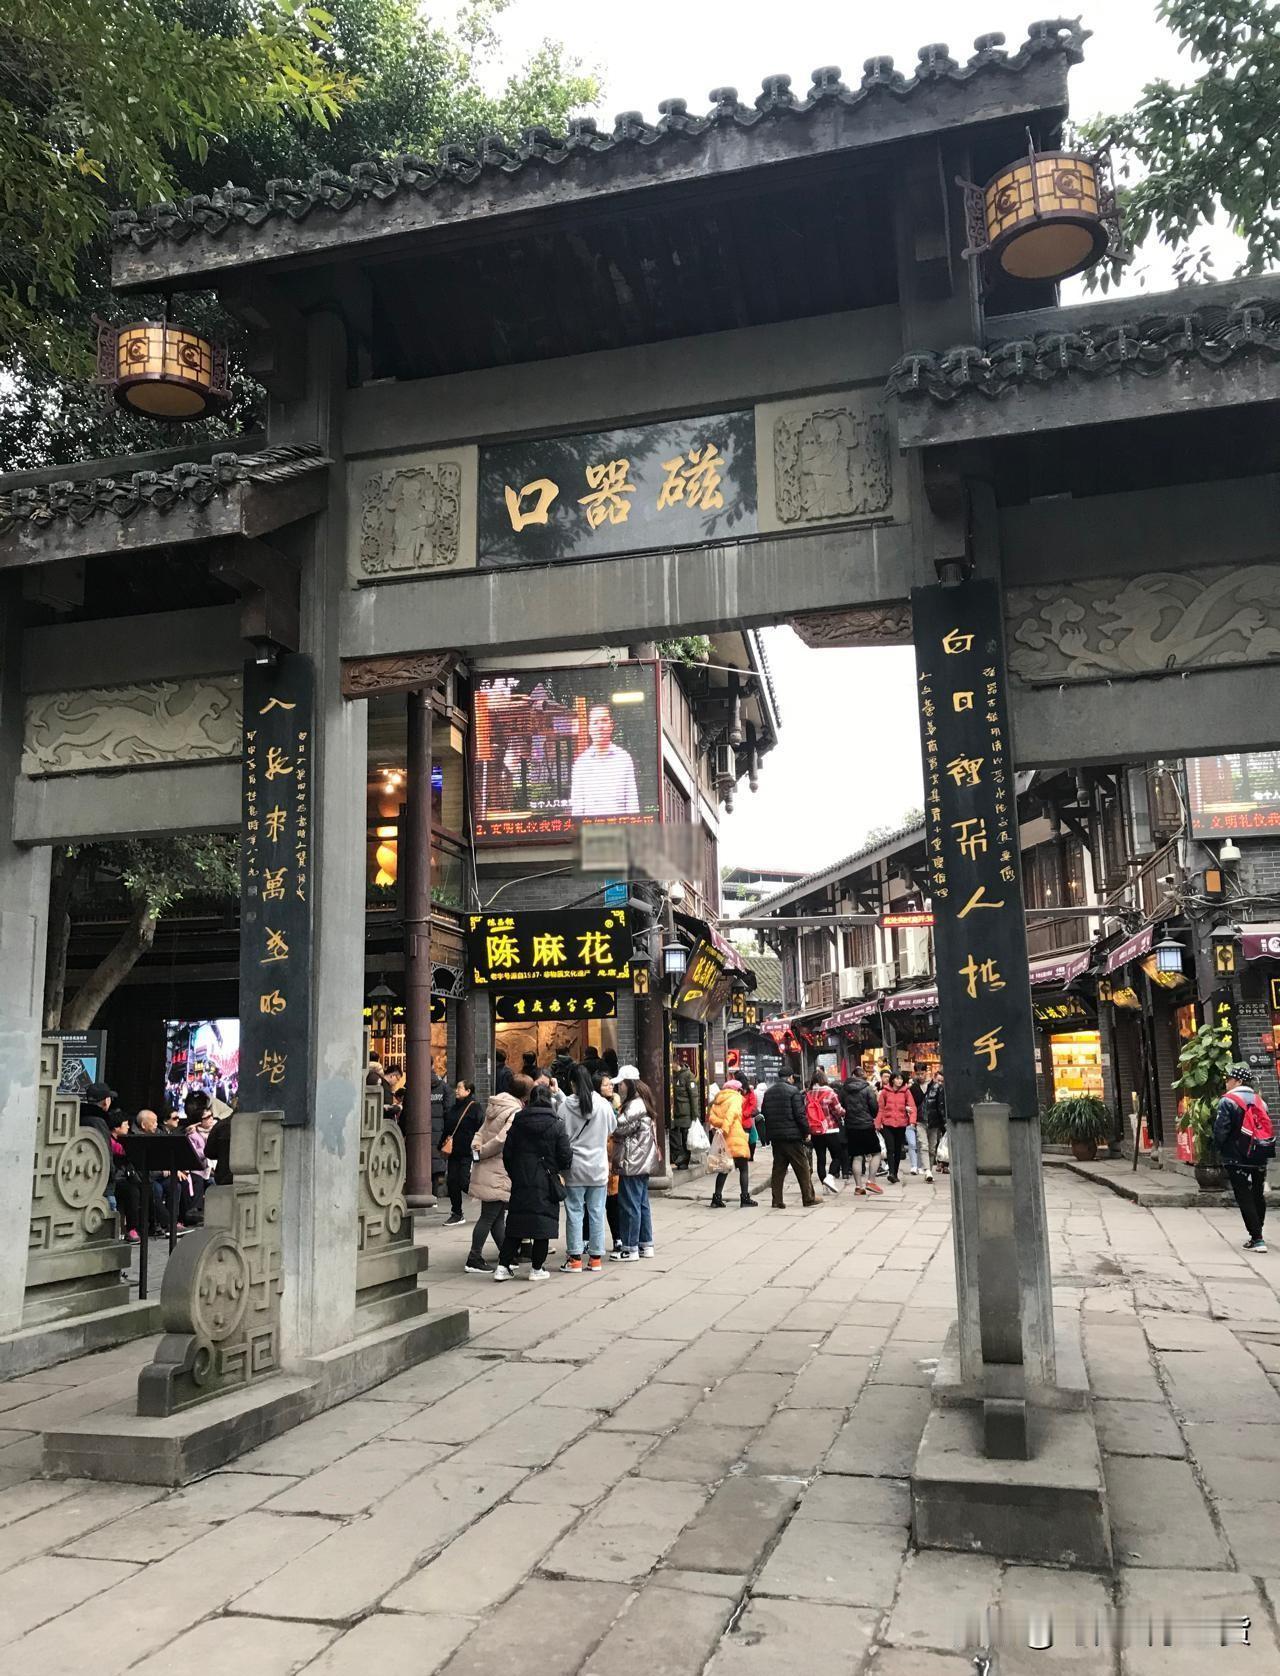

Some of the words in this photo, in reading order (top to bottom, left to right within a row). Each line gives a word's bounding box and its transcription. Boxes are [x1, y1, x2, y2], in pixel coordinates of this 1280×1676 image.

[485, 930, 614, 969] 陈麻花
[513, 996, 597, 1015] 重庆老字号
